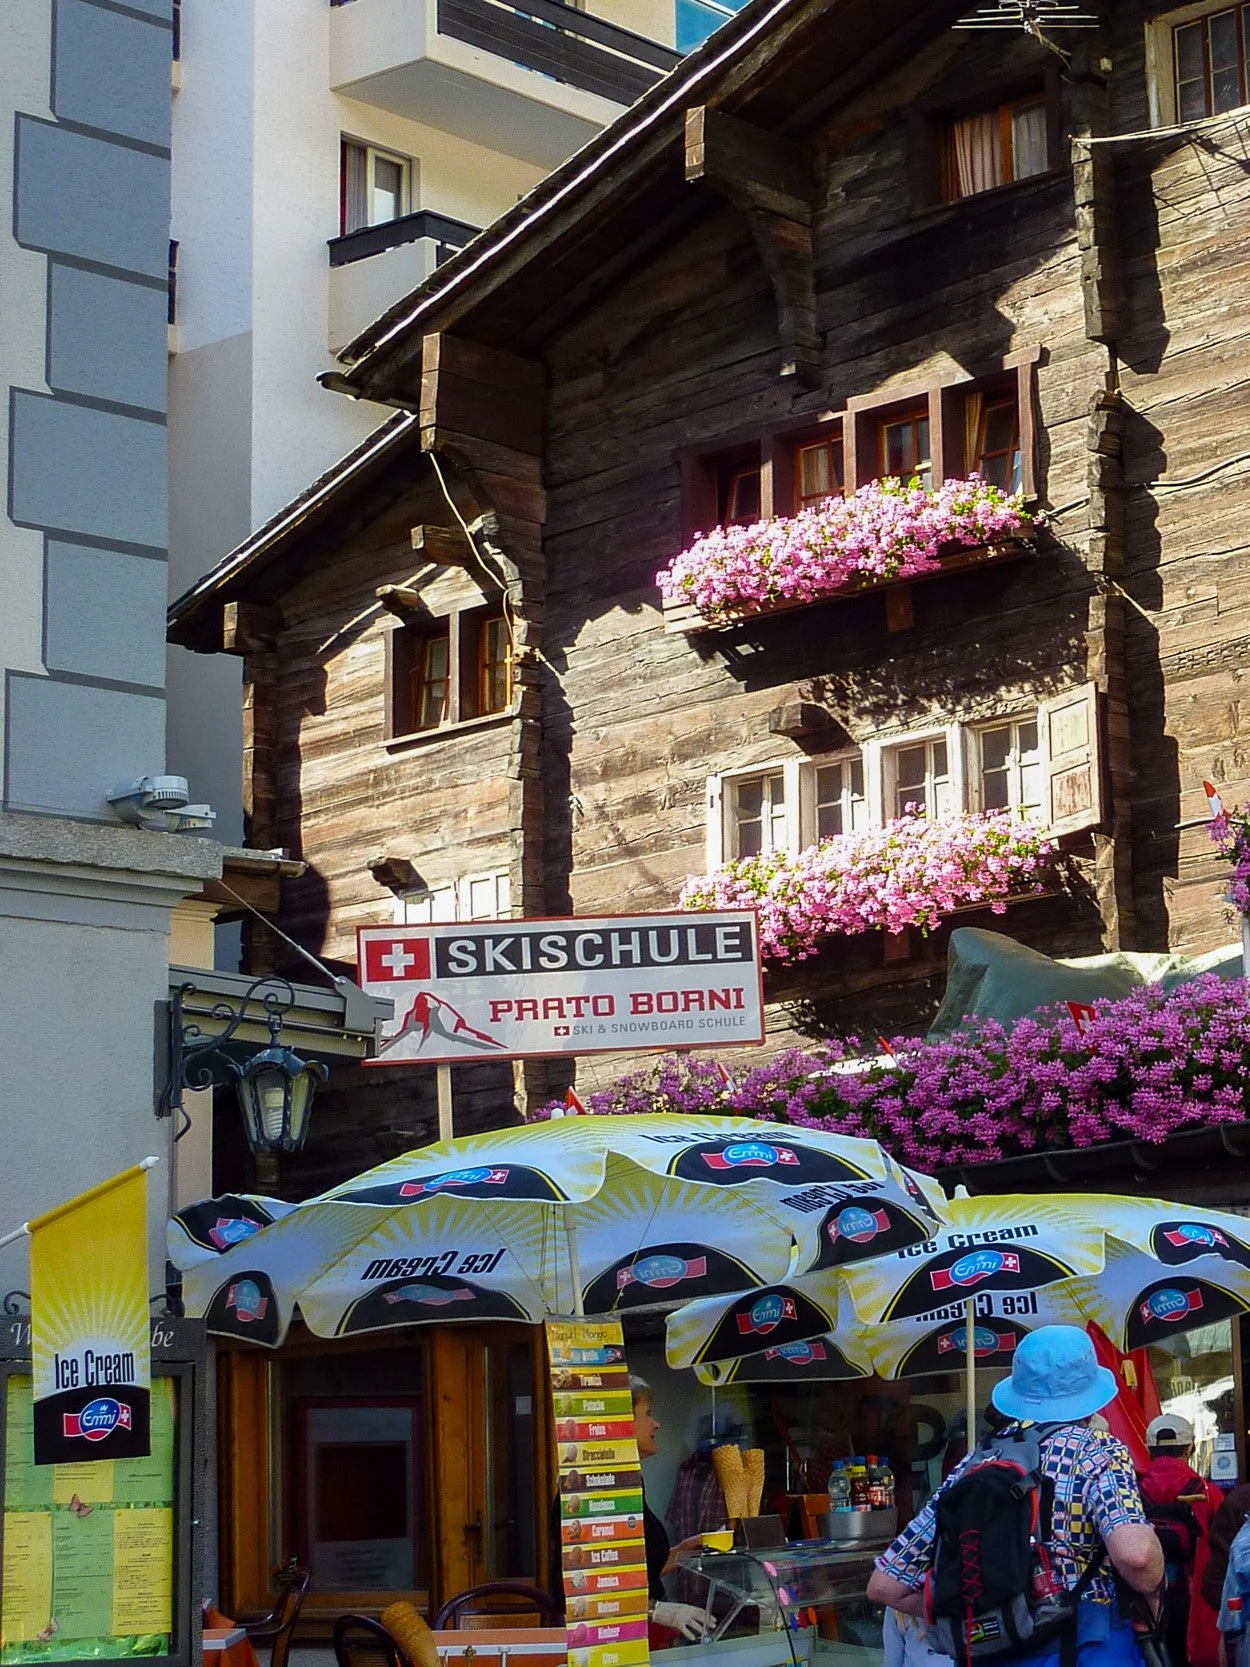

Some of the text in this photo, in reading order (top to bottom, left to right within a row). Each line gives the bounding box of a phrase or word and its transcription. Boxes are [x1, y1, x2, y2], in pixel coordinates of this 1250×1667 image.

[447, 925, 743, 975] SKISCHULE
[489, 987, 745, 1023] PRATO BORNI
[572, 1015, 747, 1035] SKI & SNOWBOARD SCHULE
[728, 1146, 776, 1162] Emmi
[947, 1224, 1039, 1252] Cream
[955, 1255, 1000, 1275] Emmi
[752, 1303, 782, 1323] Emmi
[54, 1348, 135, 1390] Ice Cream
[82, 1408, 119, 1428] Emmi
